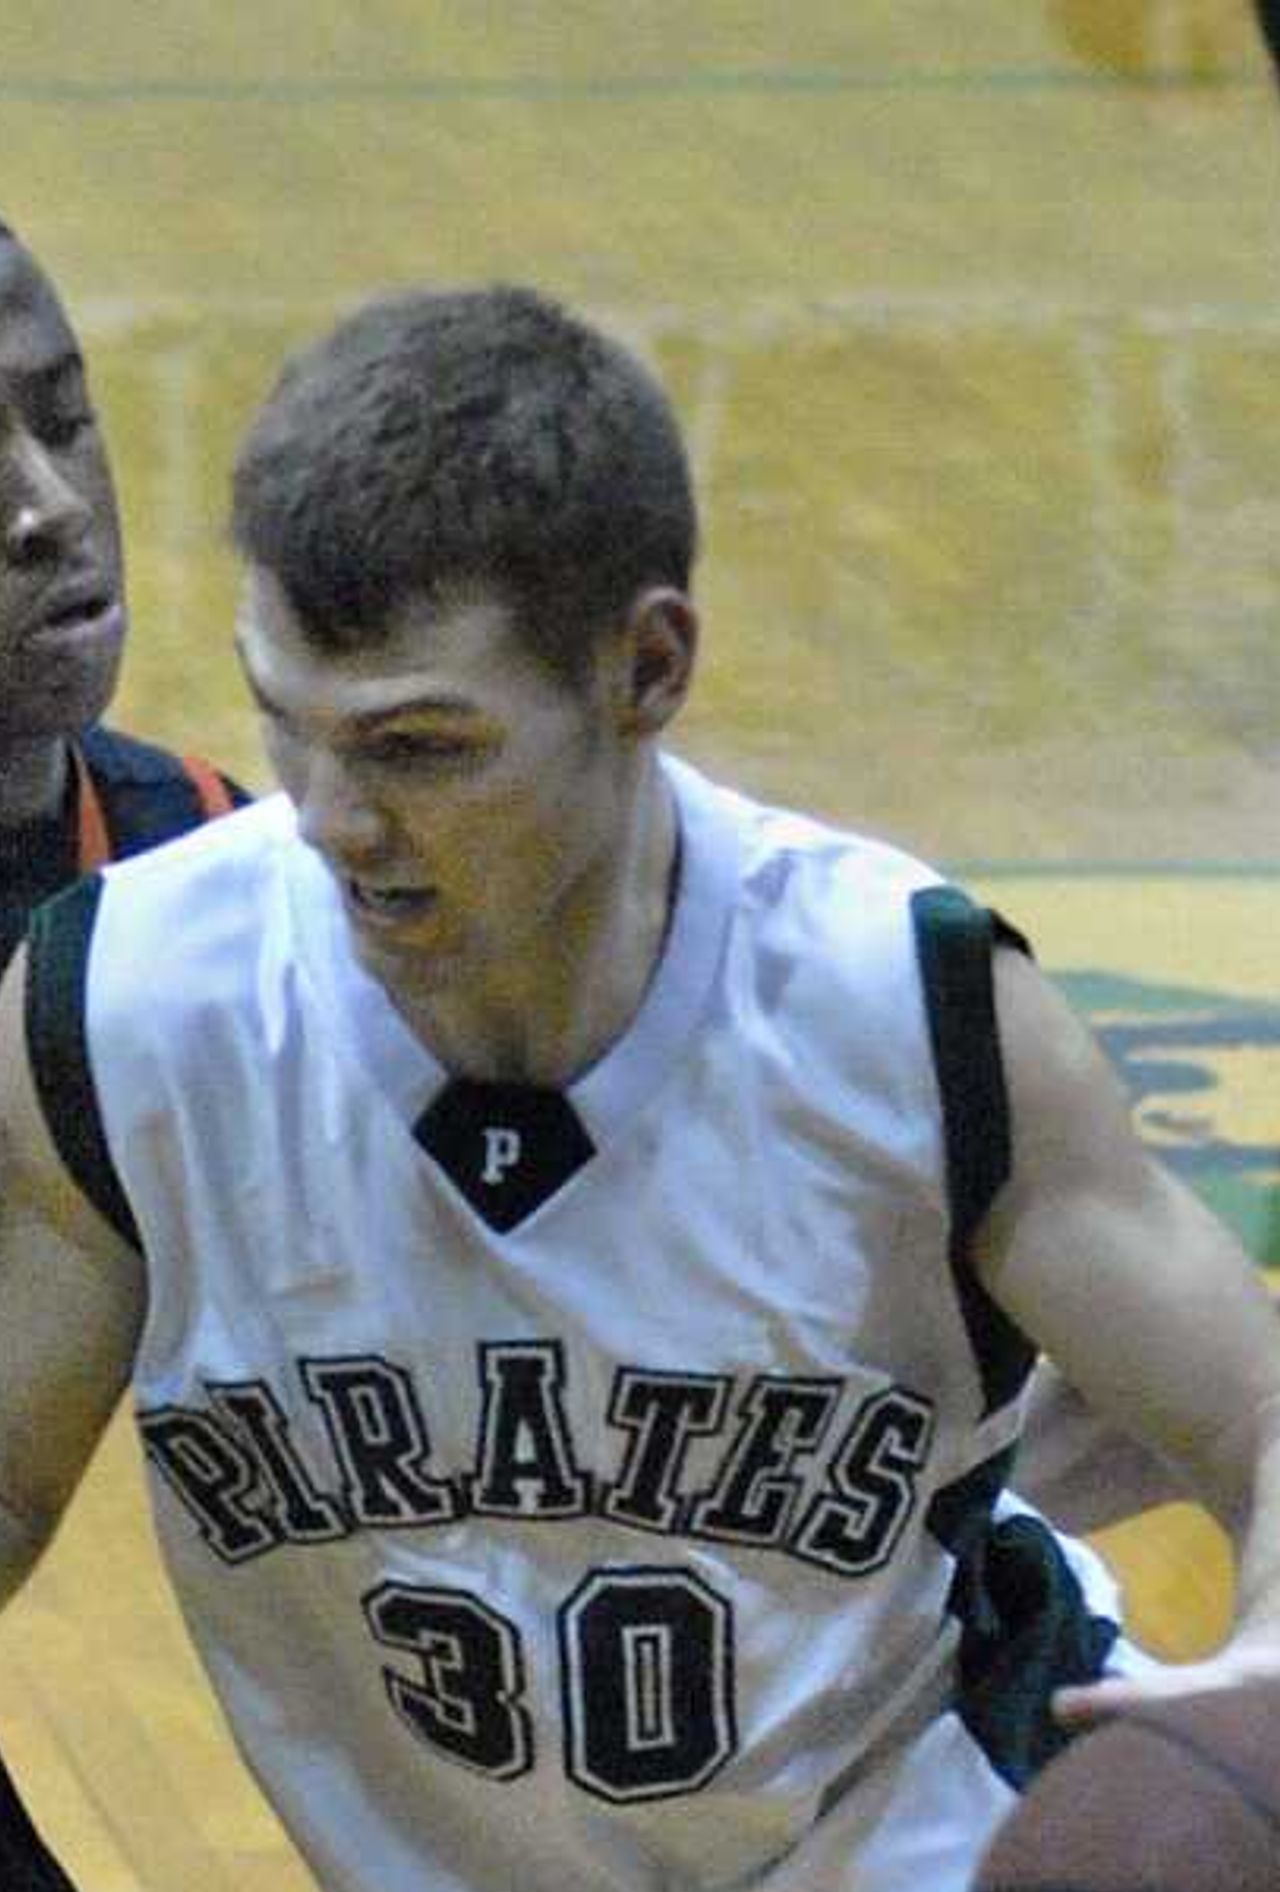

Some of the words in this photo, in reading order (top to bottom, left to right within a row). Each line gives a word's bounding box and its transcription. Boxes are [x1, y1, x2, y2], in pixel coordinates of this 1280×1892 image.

[481, 1127, 522, 1182] P
[136, 1340, 934, 1577] PIRATES
[360, 1564, 738, 1806] 30
